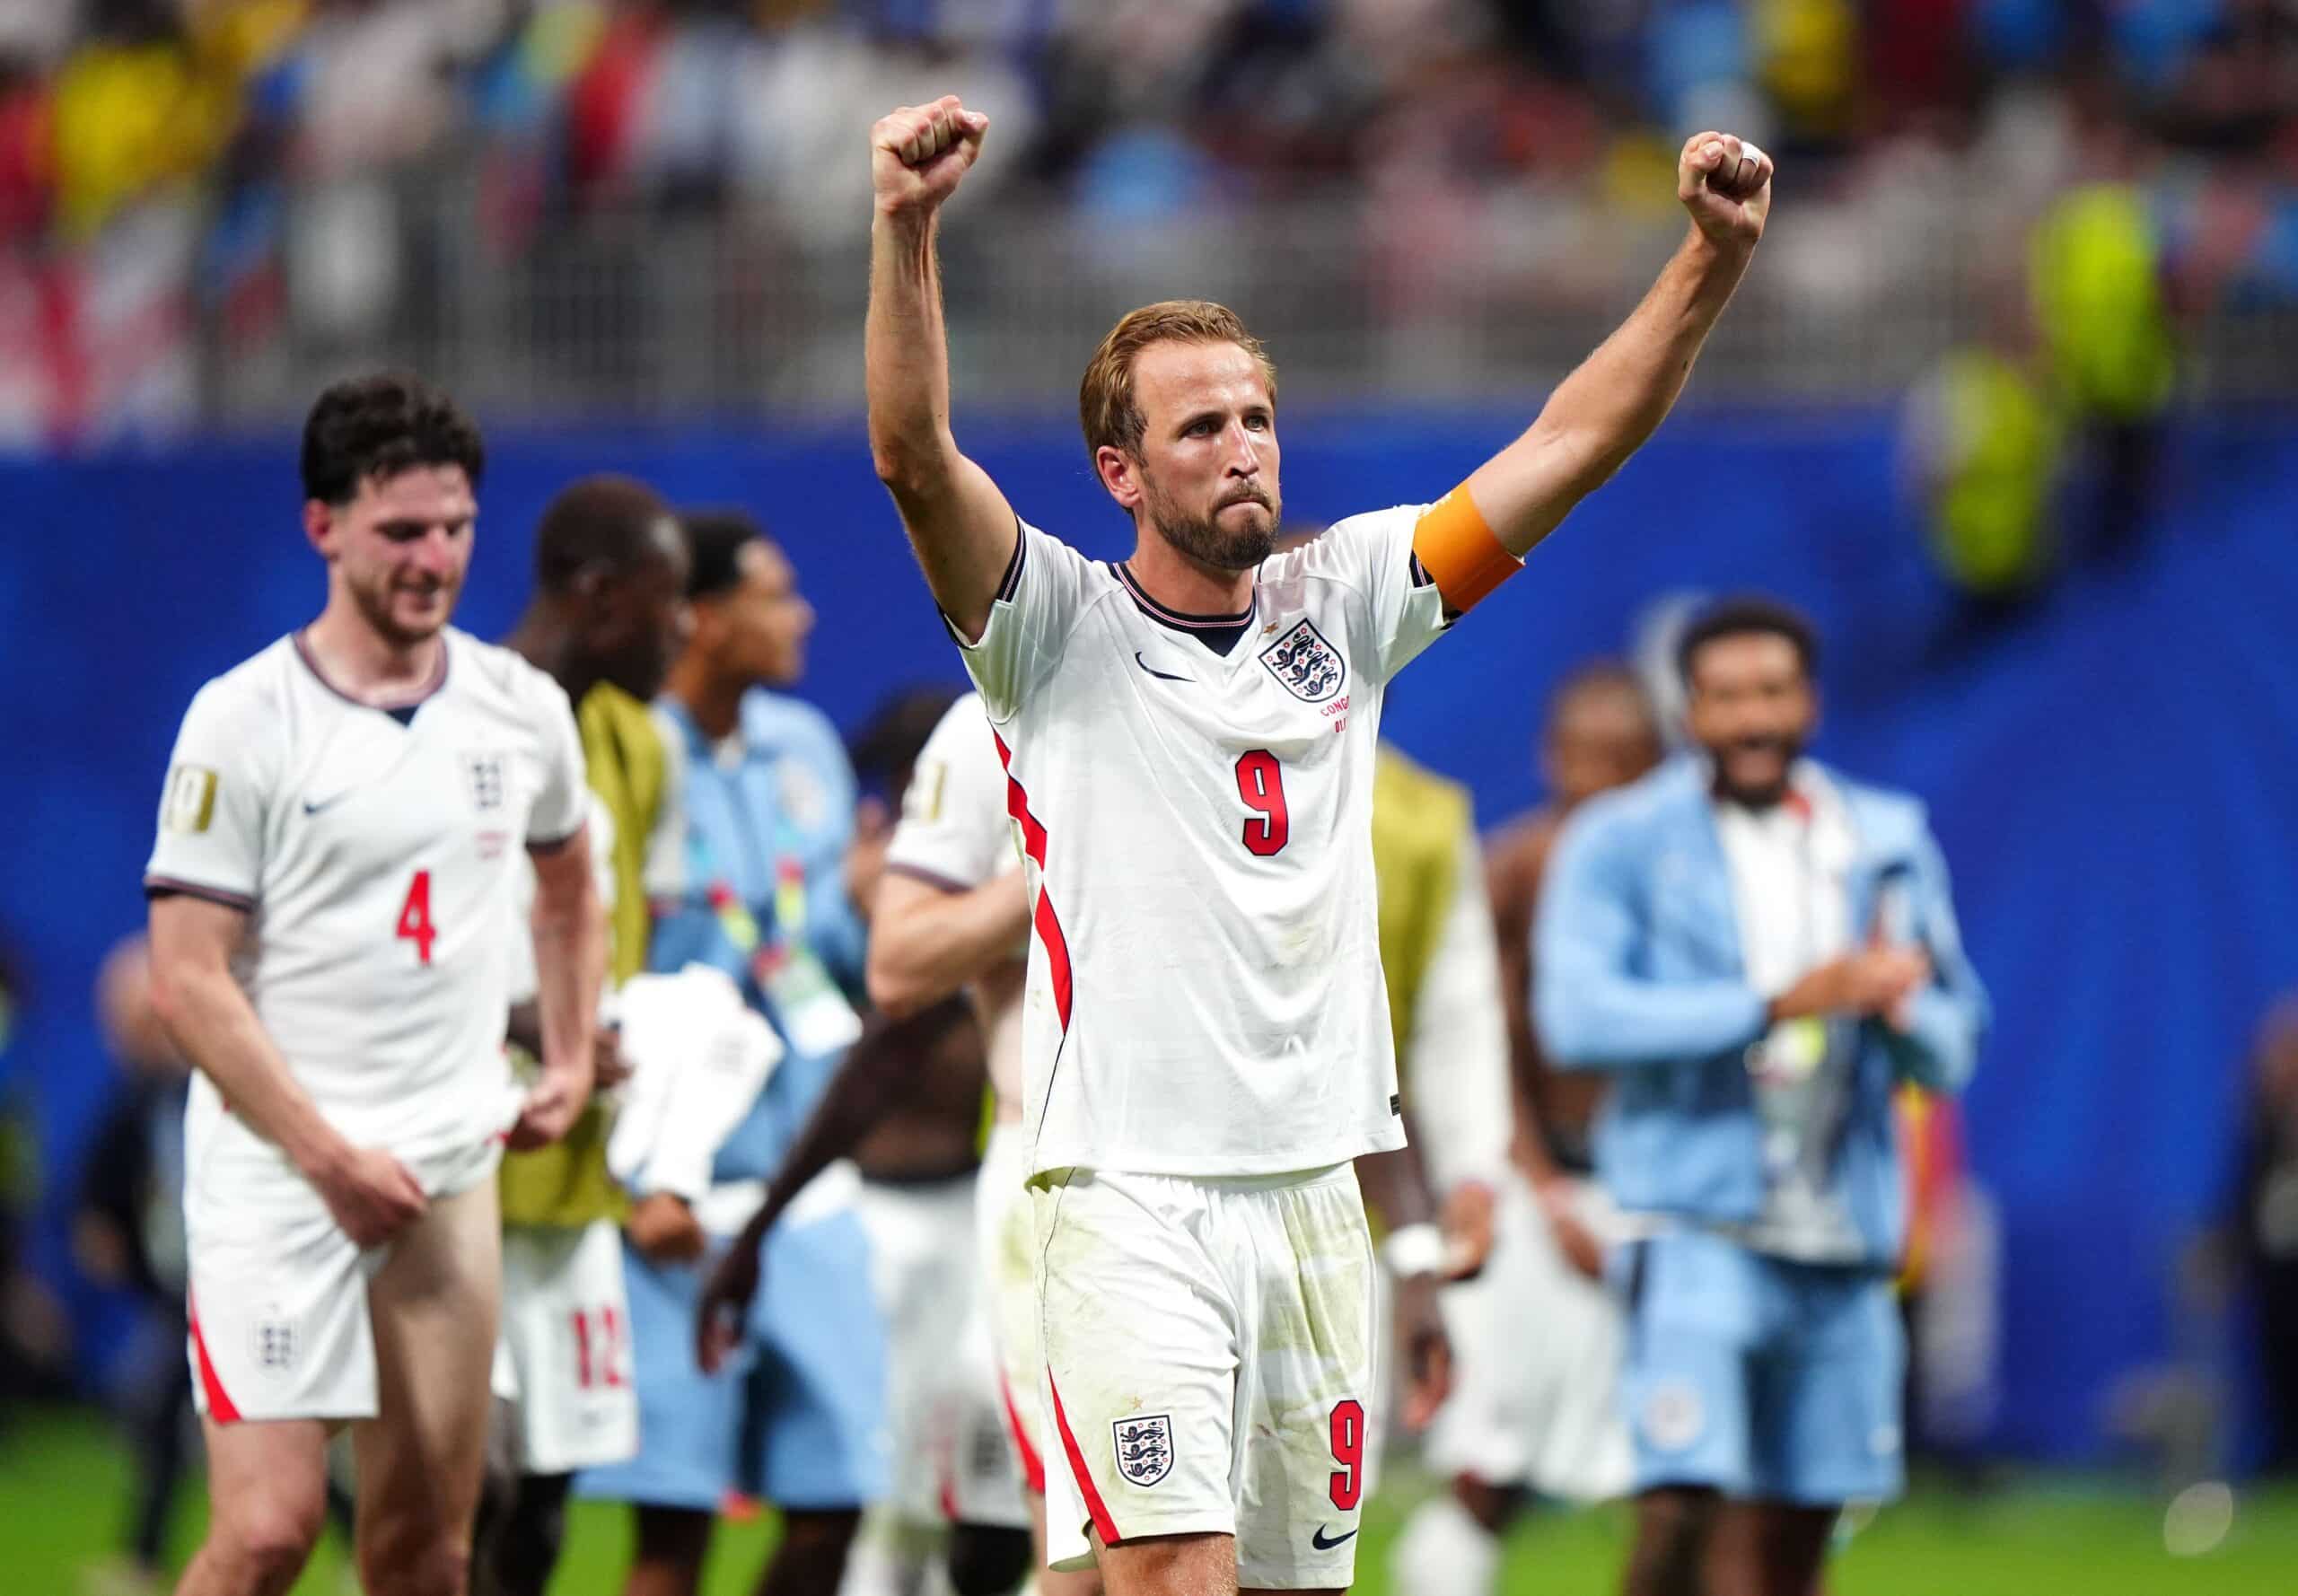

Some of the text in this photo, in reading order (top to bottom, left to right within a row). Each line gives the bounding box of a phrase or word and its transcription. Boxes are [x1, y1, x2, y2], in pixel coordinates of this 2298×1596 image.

[1235, 749, 1289, 856] 9
[397, 869, 436, 968] 4
[1329, 1399, 1364, 1511] 9
